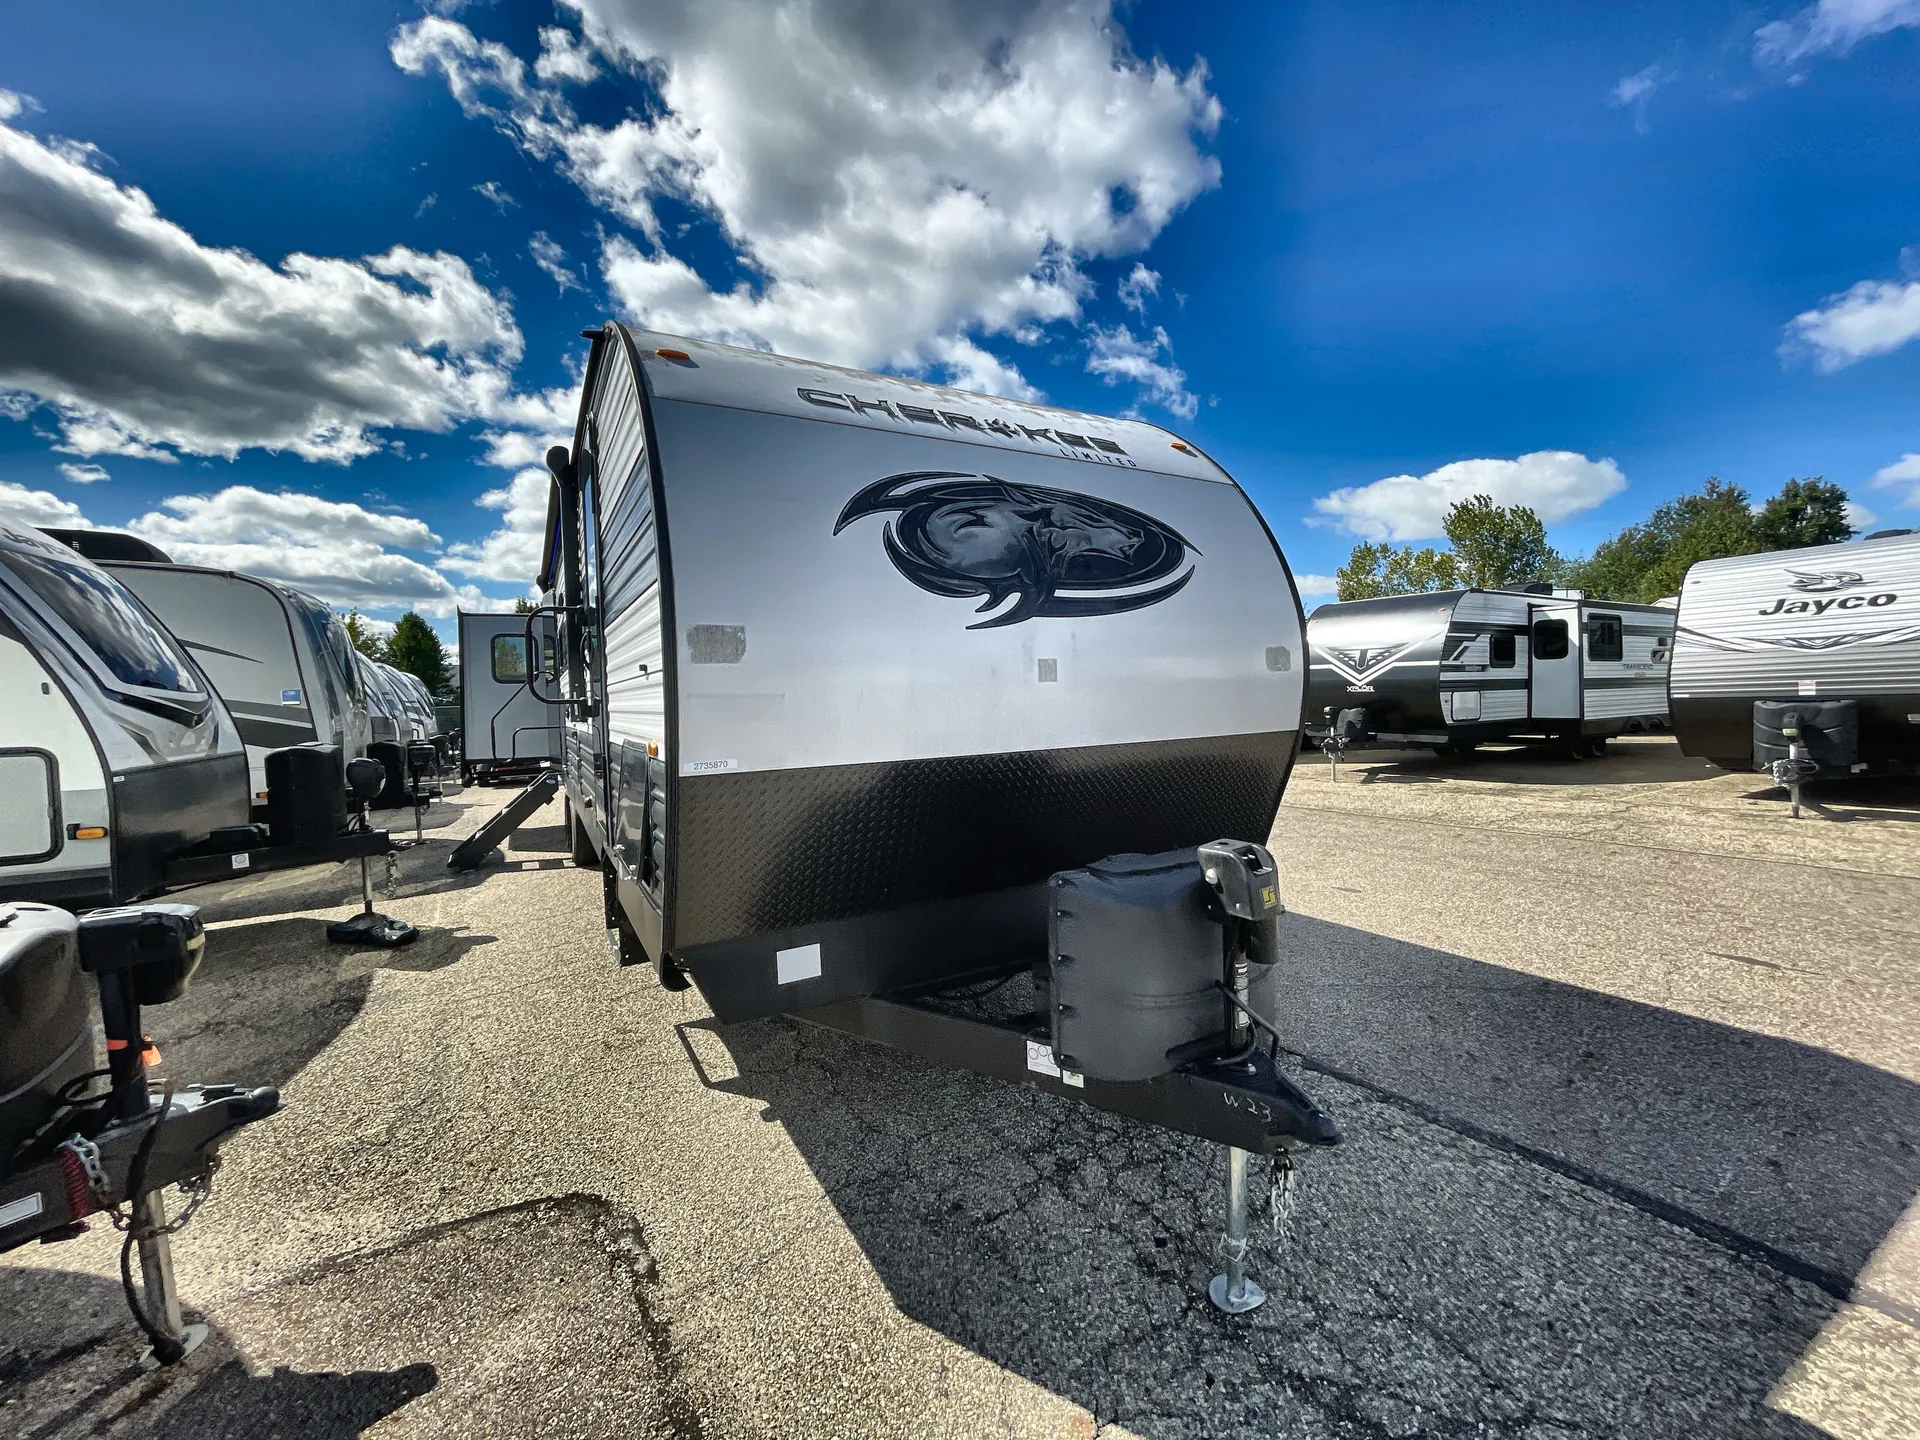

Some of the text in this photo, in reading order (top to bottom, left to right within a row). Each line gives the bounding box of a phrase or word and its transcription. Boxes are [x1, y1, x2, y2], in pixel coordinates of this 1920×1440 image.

[1060, 448, 1137, 467] LIMITED
[1758, 593, 1898, 616] Jayco
[693, 760, 728, 770] 2735870
